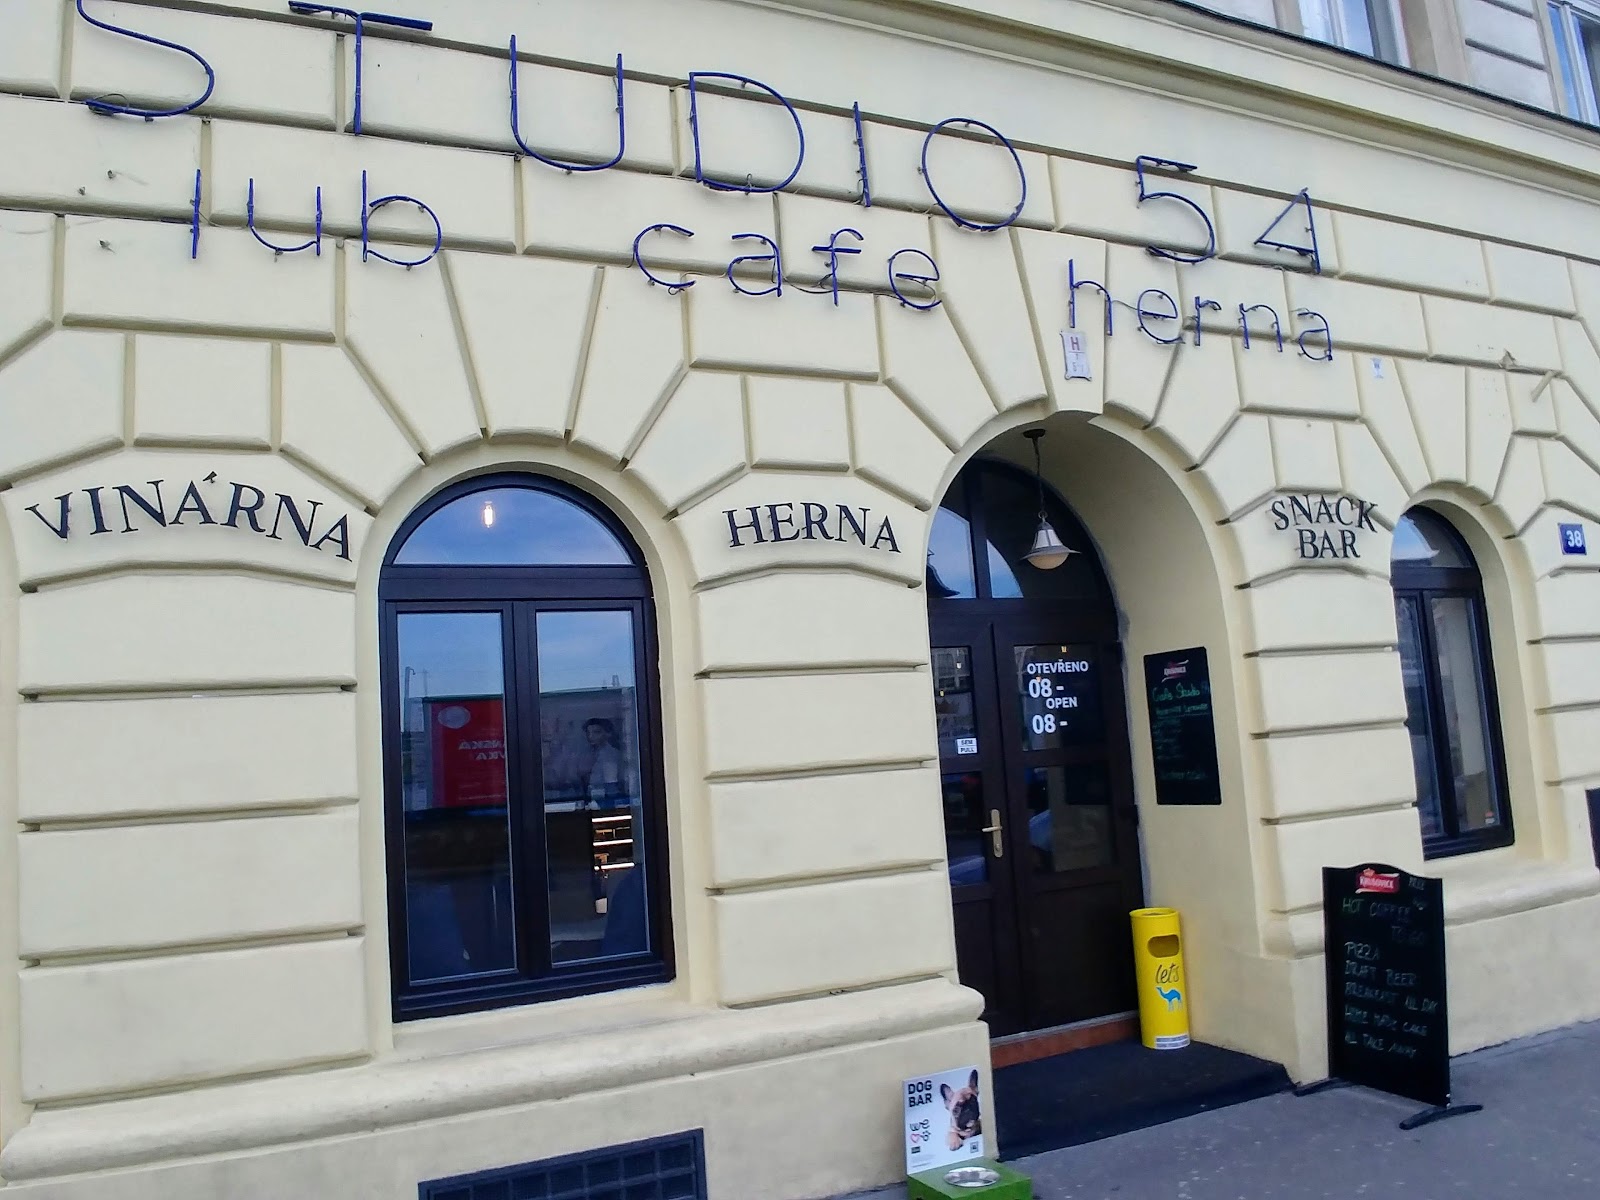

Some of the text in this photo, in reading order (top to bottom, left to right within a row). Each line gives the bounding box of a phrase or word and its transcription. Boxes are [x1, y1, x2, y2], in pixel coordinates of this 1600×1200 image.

[79, 0, 1322, 275] STUDIO 54
[633, 223, 942, 309] cafe
[1069, 259, 1333, 361] herna
[25, 471, 353, 562] VINÁRNA
[1271, 493, 1378, 533] SNACK
[722, 502, 901, 553] HERNA
[1296, 528, 1361, 559] BAR
[1566, 530, 1583, 547] 38
[1027, 659, 1089, 674] OTEVŘENO
[1029, 678, 1052, 698] 08
[1046, 696, 1078, 709] OPEN
[1032, 713, 1056, 734] 08
[908, 1080, 932, 1095] DOG
[908, 1093, 933, 1107] BAR
